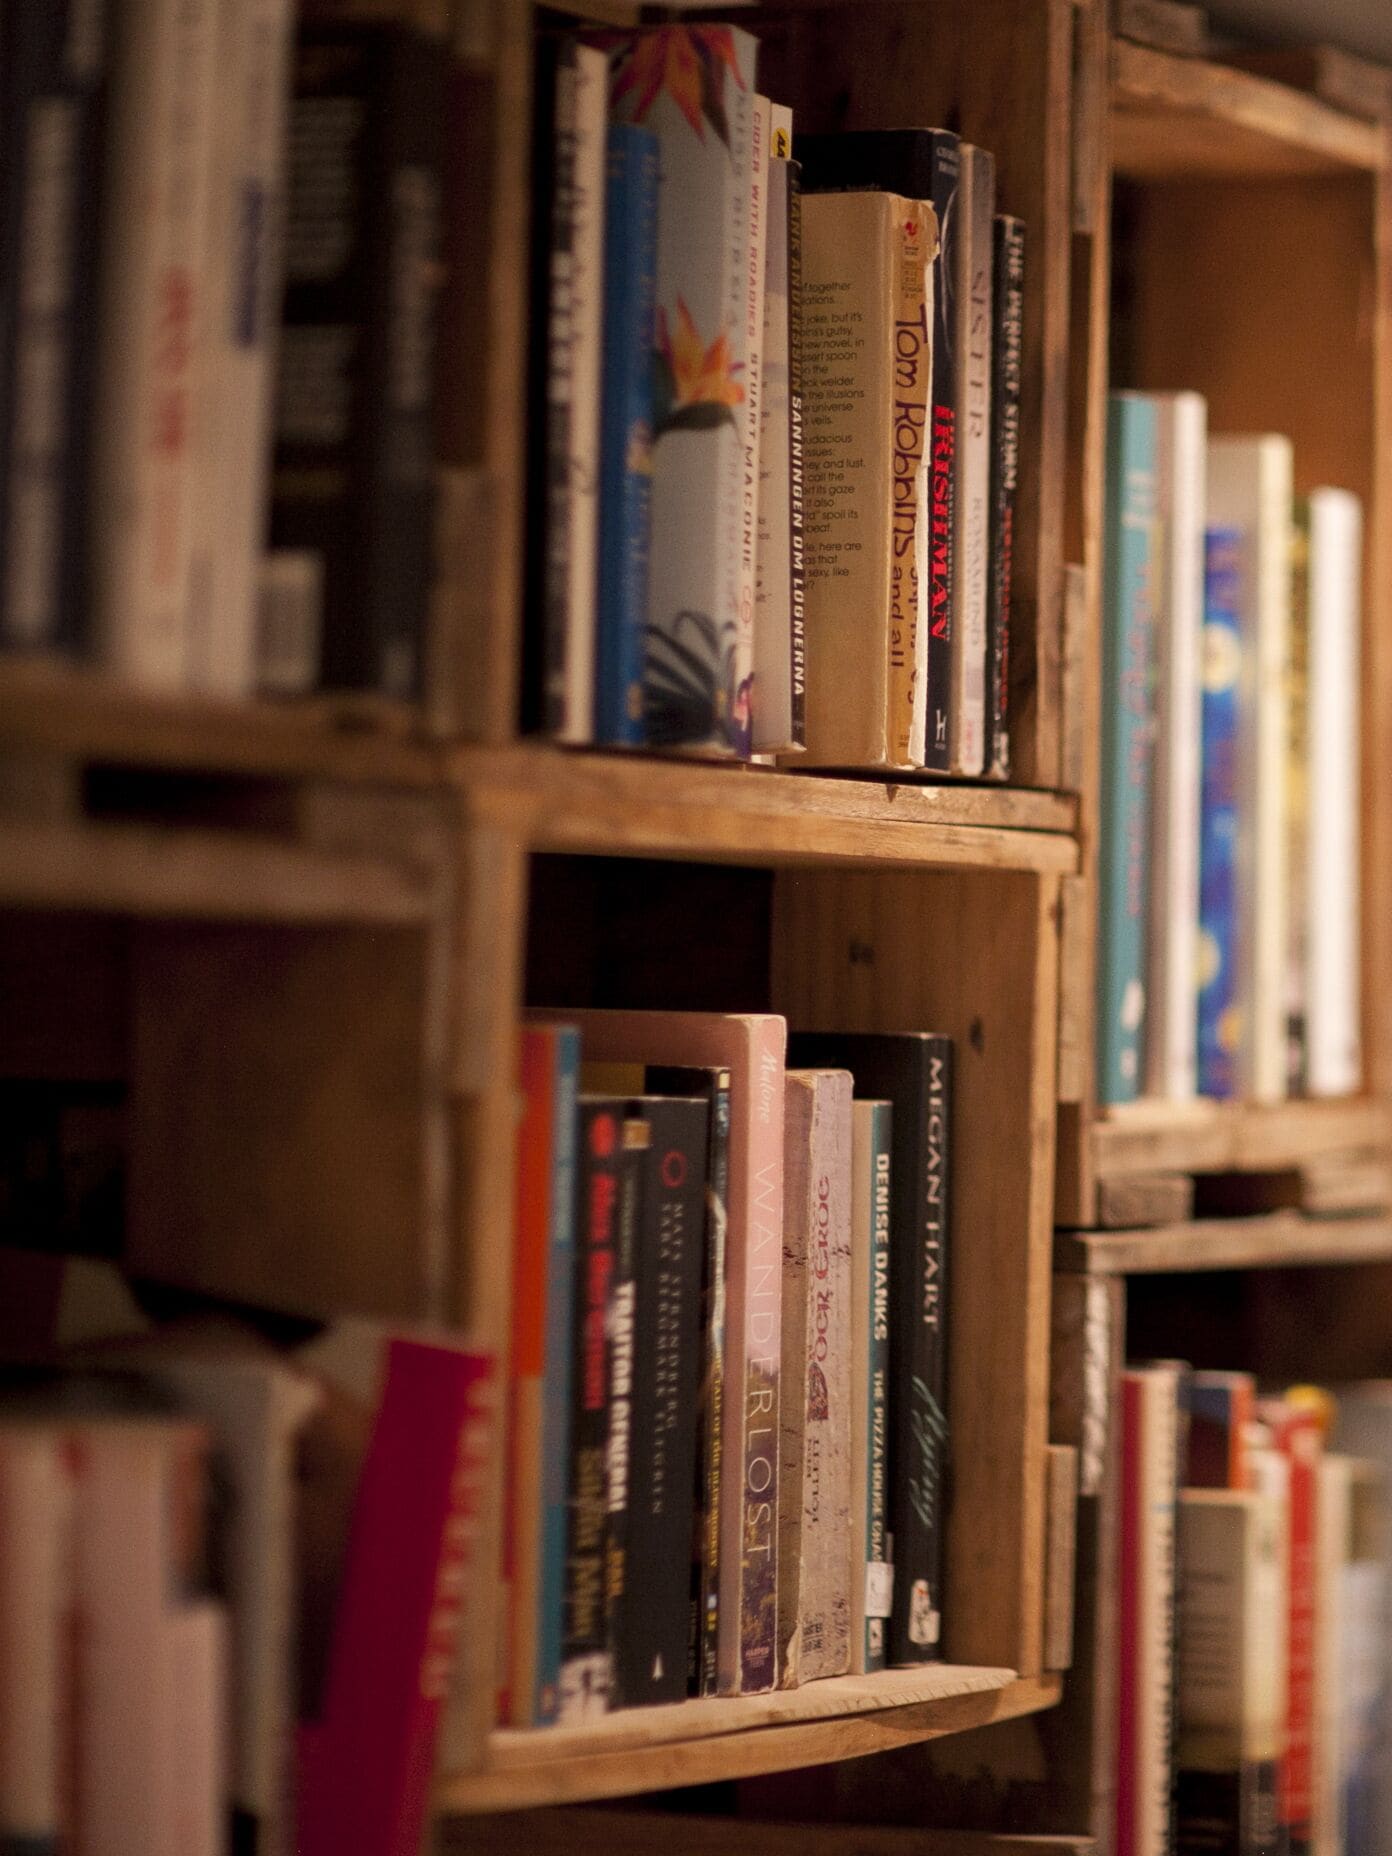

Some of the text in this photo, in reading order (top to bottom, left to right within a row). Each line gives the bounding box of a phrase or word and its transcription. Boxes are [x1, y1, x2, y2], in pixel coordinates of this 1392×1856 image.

[808, 282, 850, 294] together
[832, 312, 848, 323] but
[850, 312, 864, 322] it's
[742, 111, 762, 570] CIDER WITH ROADIES STUART MACONIE
[855, 338, 864, 348] in
[896, 303, 928, 388] Tom
[826, 351, 857, 363] spoon
[970, 269, 985, 438] SISTER
[812, 364, 828, 374] the
[820, 377, 854, 386] welder
[808, 388, 864, 400] the illusions
[811, 401, 854, 413] universe
[792, 396, 804, 529] SANNINGEN
[823, 459, 844, 470] and
[808, 472, 844, 483] call the
[893, 400, 926, 557] Robbins
[828, 485, 855, 497] gaze
[814, 498, 834, 508] also
[822, 510, 846, 521] spoil
[848, 510, 858, 520] its
[931, 405, 956, 640] IRISHMAN
[793, 536, 804, 570] OM
[818, 542, 842, 551] here
[844, 542, 862, 551] are
[818, 554, 838, 564] that
[832, 566, 850, 577] like
[890, 566, 905, 667] and all
[922, 1057, 944, 1333] MEGAN HART
[874, 1153, 890, 1341] DENISE DANKS
[746, 1046, 779, 1562] Malone WANDERLOST
[613, 1280, 636, 1397] TRAITOR
[872, 1369, 884, 1402] THE
[872, 1406, 884, 1459] PIZZA
[608, 1400, 632, 1512] GENERAL
[871, 1462, 884, 1518] HOUSE
